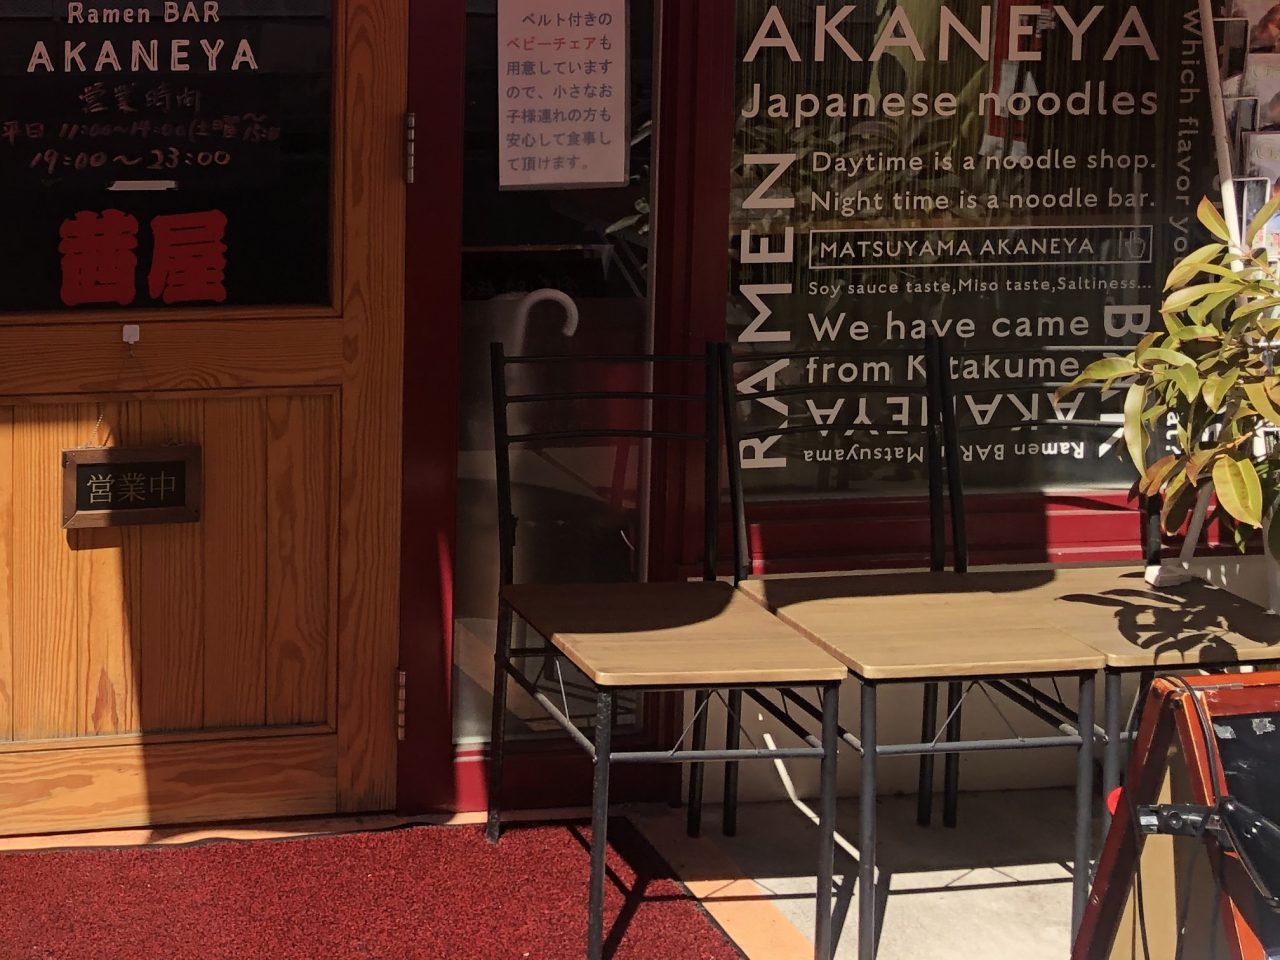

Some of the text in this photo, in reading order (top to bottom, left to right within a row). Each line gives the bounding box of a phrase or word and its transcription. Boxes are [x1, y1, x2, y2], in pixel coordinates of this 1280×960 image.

[68, 0, 220, 24] Ramen BAR
[522, 11, 613, 27] ベルト付きの
[742, 4, 1160, 63] AKANEYA
[27, 38, 259, 72] AKANEYA
[1180, 7, 1202, 104] Which
[506, 59, 613, 76] 用意しています
[506, 83, 613, 100] ので、小さなお
[506, 107, 612, 124] 子様連れの方も
[741, 80, 1159, 128] Japanese noodles
[506, 131, 611, 148] 安心して食事し
[507, 155, 589, 171] て頂けます。
[812, 148, 1157, 177] Daytime is a noodle shop.
[1176, 115, 1200, 204] flavor
[810, 187, 1155, 217] Night time is a noodle bar.
[820, 238, 1094, 258] MATSUYAMA AKANEYA
[808, 281, 840, 298] Soy
[847, 281, 898, 295] sauce
[737, 152, 797, 469] RAMEN
[808, 310, 1089, 341] We have came
[806, 354, 1080, 384] from Ktakume
[804, 442, 924, 463] Matsuyama
[960, 443, 1005, 462] BAR
[1014, 441, 1084, 459] Ramen
[86, 471, 176, 504] 営業中
